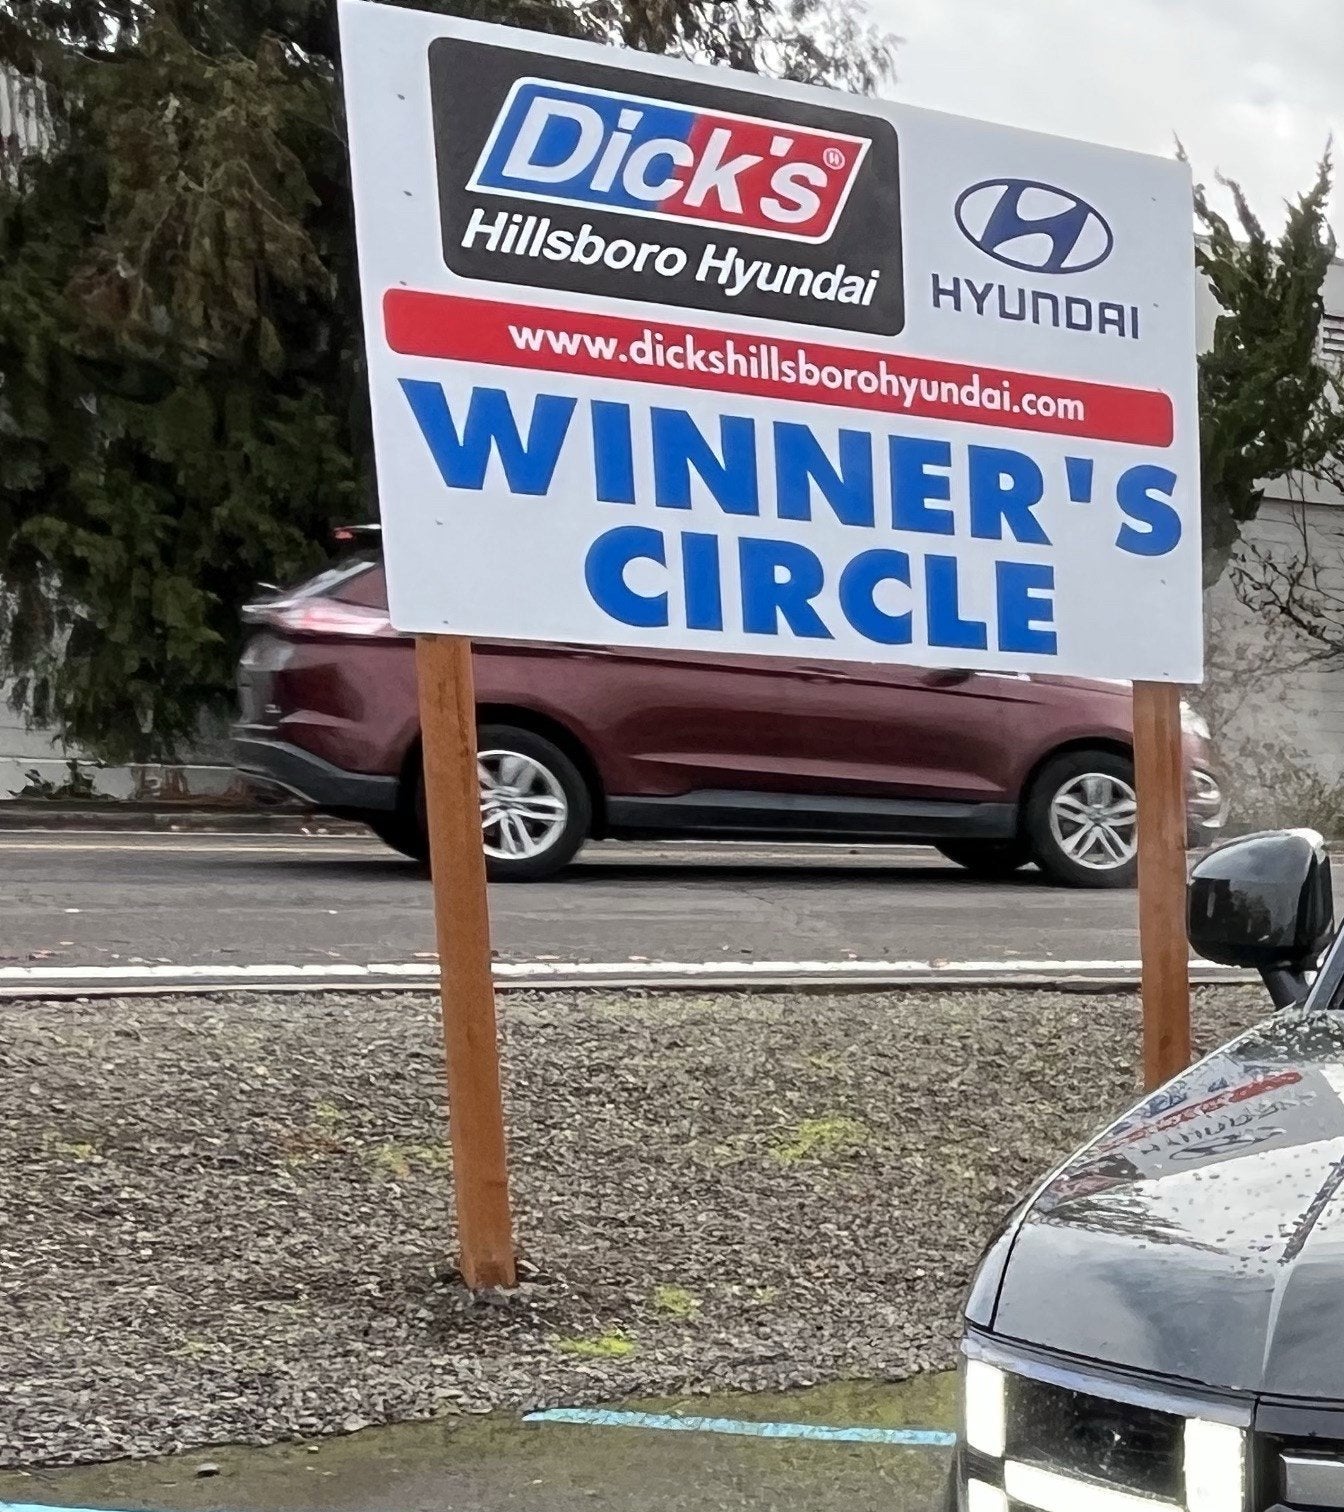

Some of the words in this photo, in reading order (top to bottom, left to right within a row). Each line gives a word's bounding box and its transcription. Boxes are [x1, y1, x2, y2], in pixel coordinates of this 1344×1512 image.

[502, 97, 828, 223] Dick's
[461, 208, 688, 277] Hillsboro
[695, 243, 880, 307] Hyundai
[931, 273, 1139, 340] HYUNDAI
[508, 321, 1086, 422] www.dickshillsborohyundai.com
[398, 378, 1183, 558] WINNER'S
[584, 525, 1058, 656] CIRCLE
